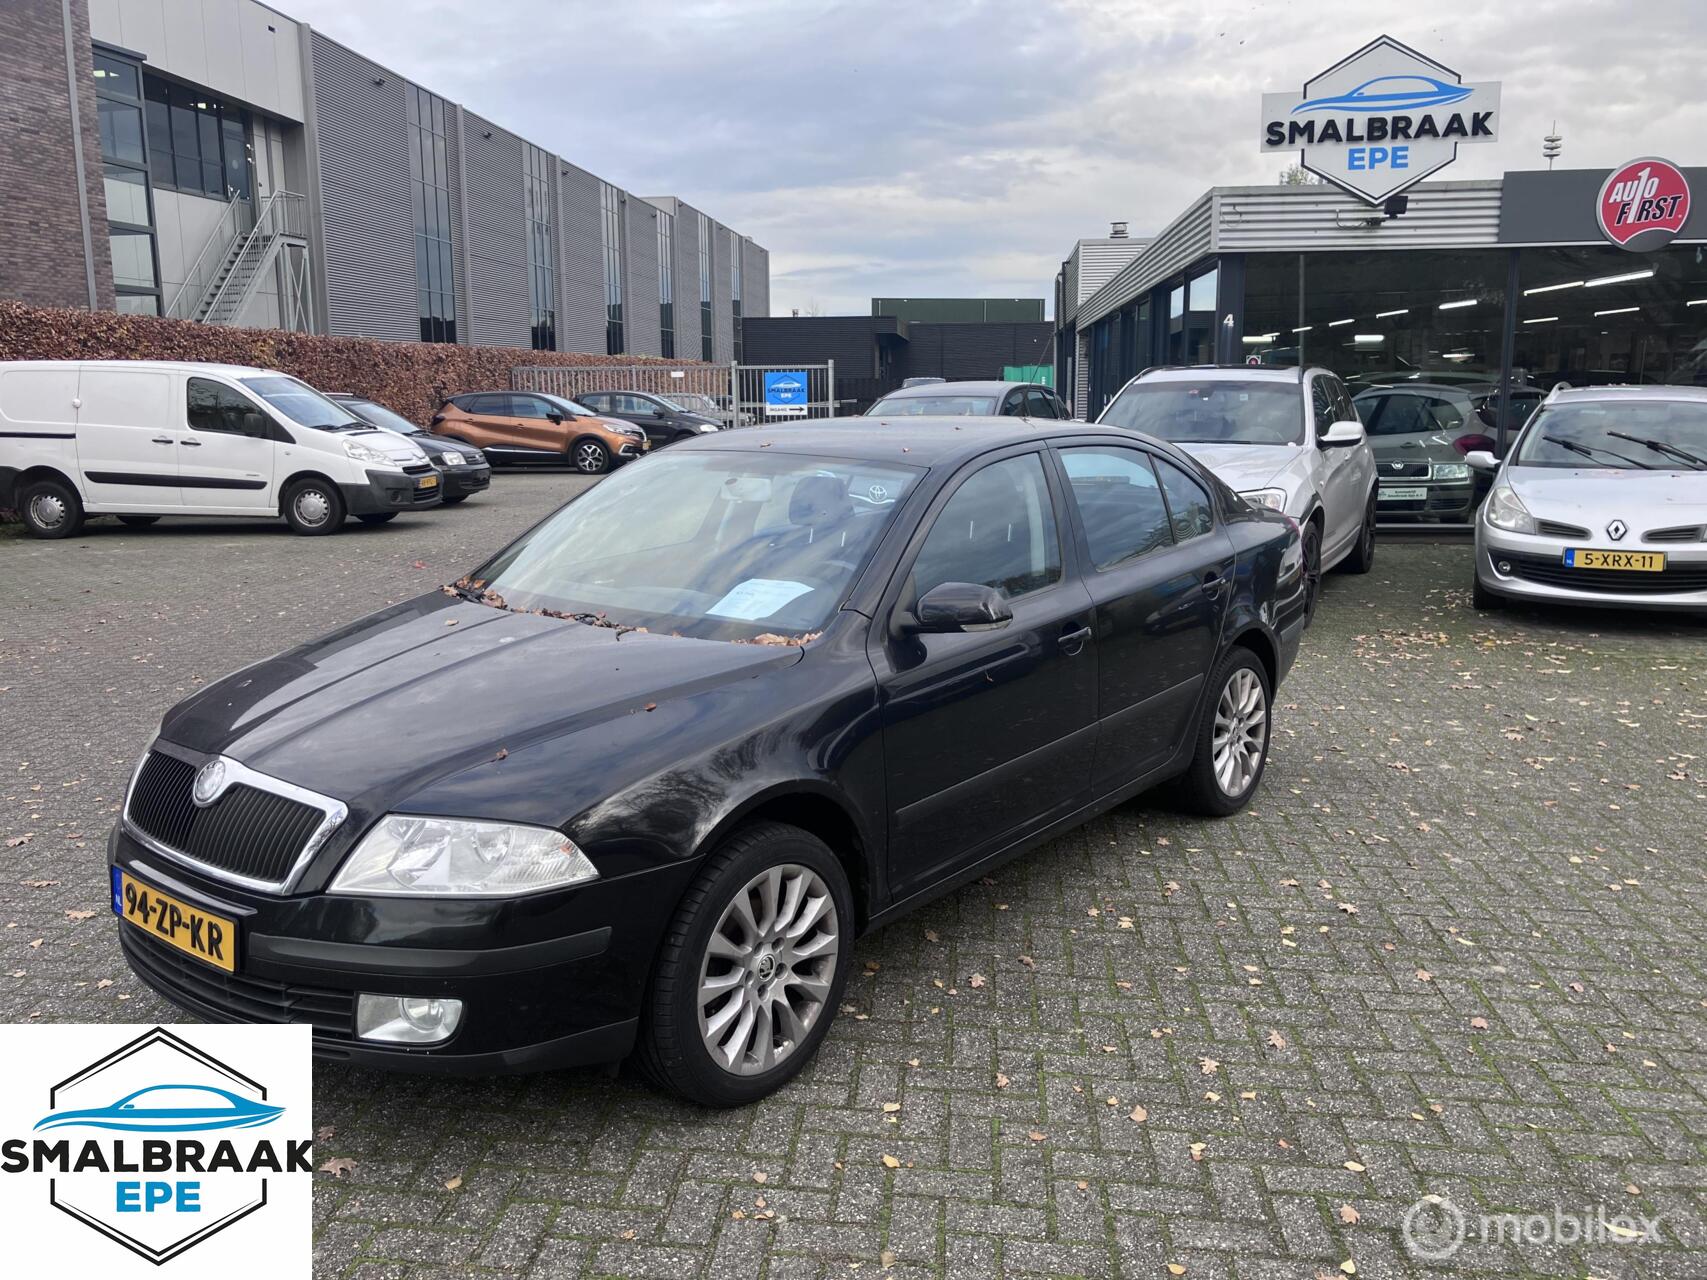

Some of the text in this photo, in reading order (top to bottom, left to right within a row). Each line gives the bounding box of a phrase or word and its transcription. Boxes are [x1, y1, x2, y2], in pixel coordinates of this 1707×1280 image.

[1265, 111, 1494, 146] SMALBRAAK
[1347, 146, 1409, 170] EPE
[1223, 313, 1234, 327] 4
[1584, 552, 1654, 569] 5-XRX-11
[125, 882, 224, 961] 94-ZP-KR
